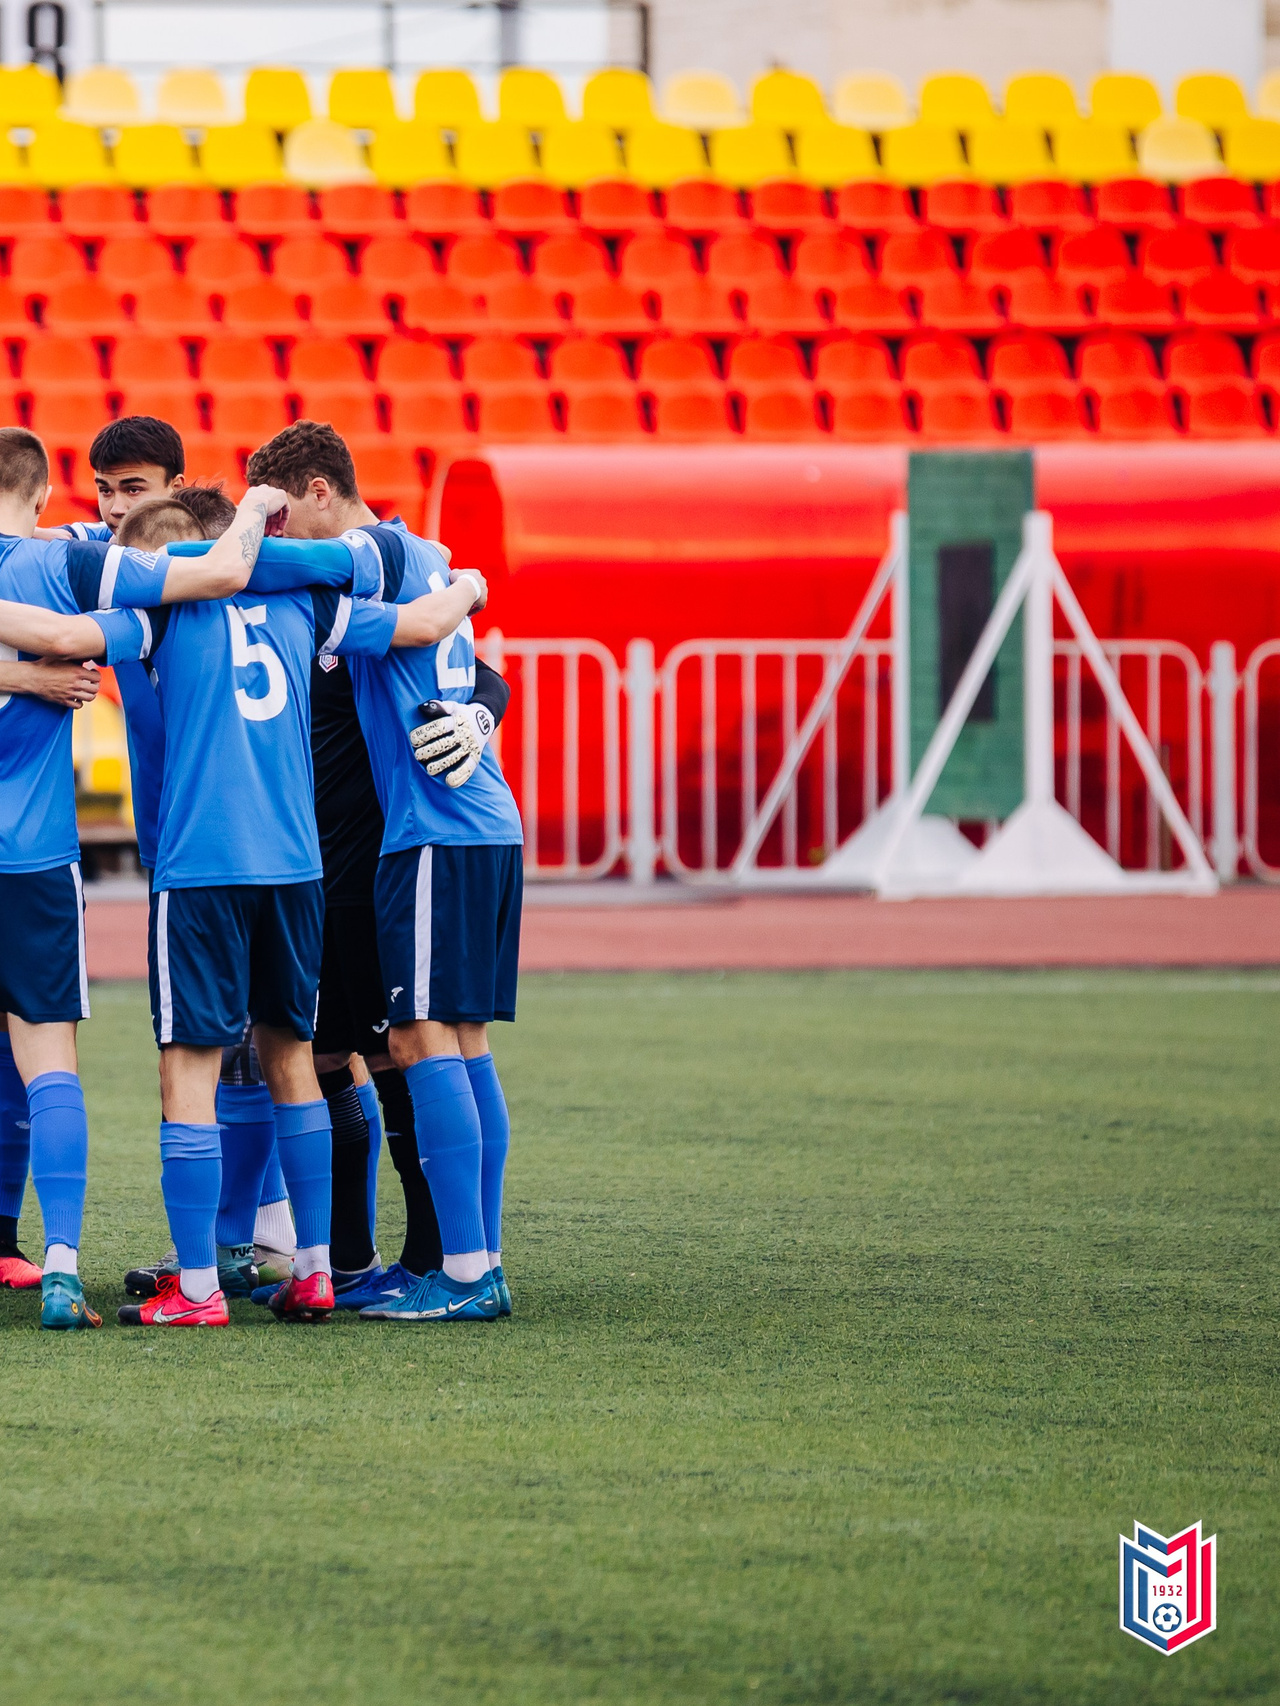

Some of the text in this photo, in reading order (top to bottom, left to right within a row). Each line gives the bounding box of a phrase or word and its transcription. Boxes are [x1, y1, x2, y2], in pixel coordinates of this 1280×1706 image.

[225, 603, 288, 722] 5
[415, 722, 438, 737] BE ONE
